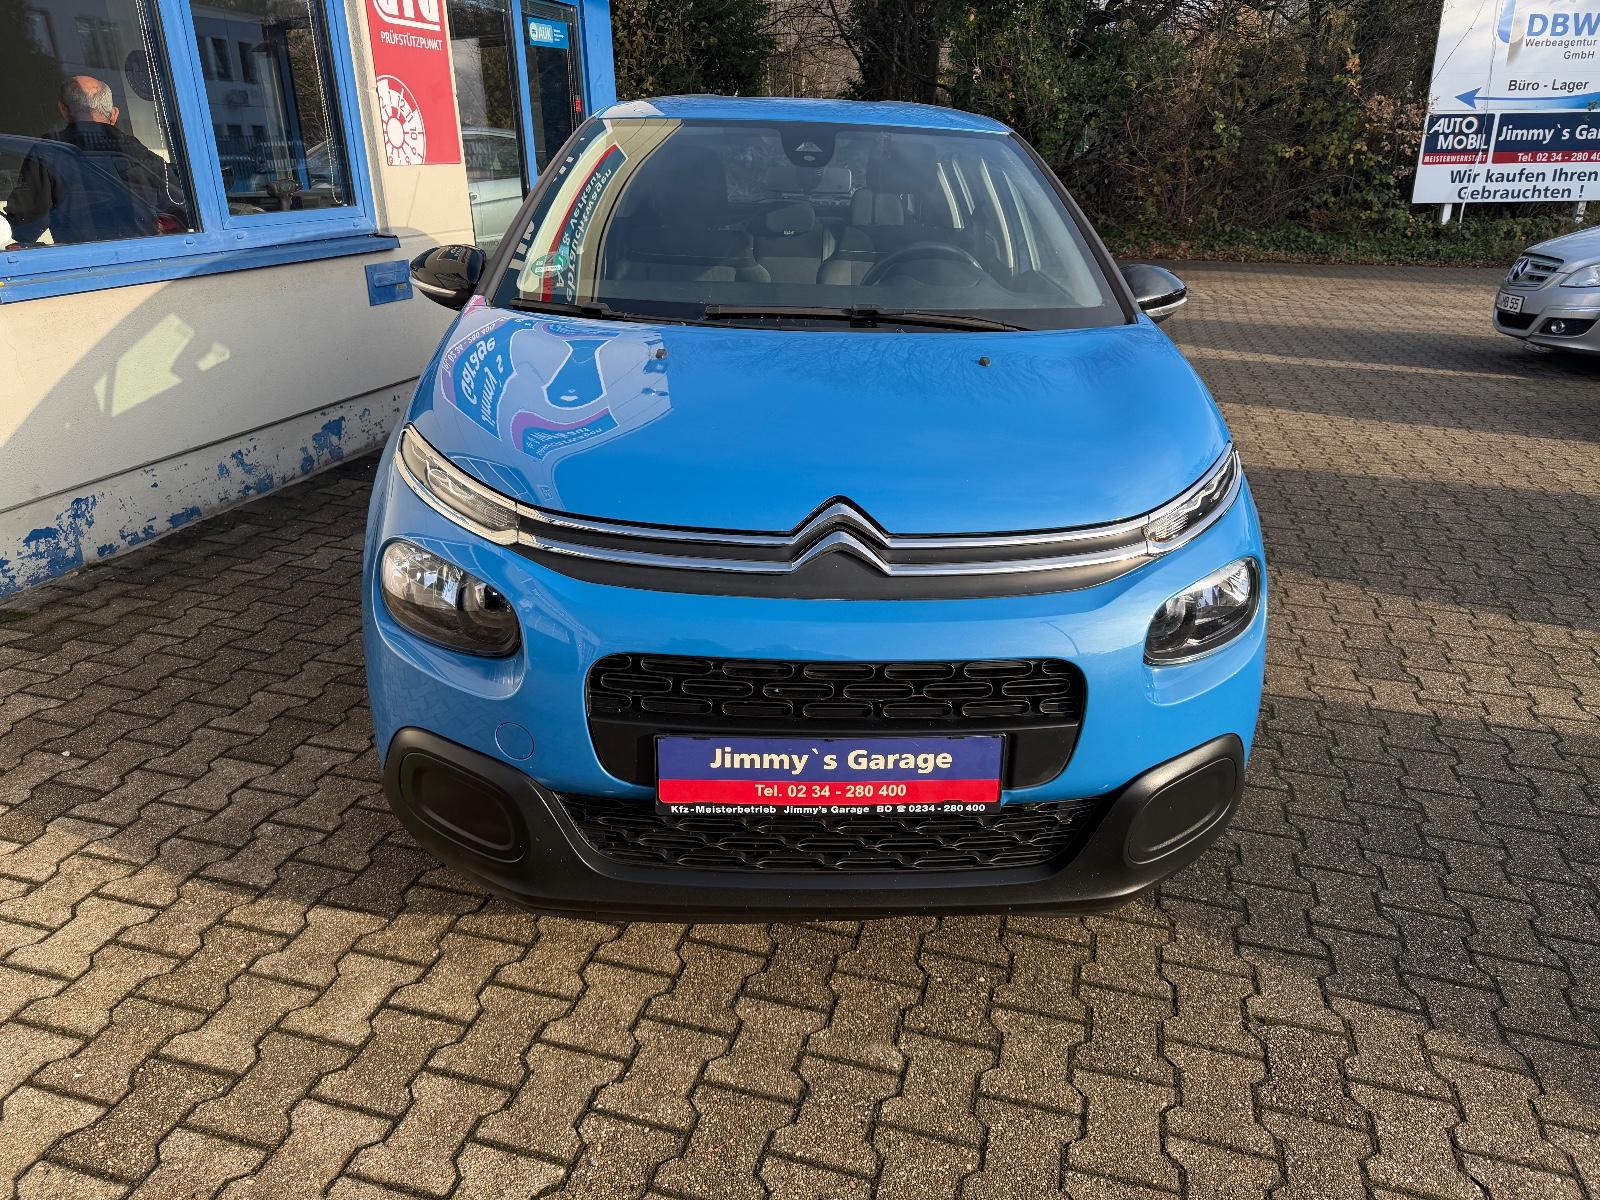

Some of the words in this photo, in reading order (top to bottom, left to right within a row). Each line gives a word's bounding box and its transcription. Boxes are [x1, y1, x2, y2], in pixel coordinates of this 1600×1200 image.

[380, 29, 442, 51] PRÜFSTÜTZPUNKT
[1525, 38, 1597, 48] Werbeagentur
[1563, 50, 1595, 60] GmbH
[1508, 79, 1540, 91] Büro
[1551, 78, 1589, 93] Lager
[1429, 116, 1478, 134] AUTO
[1437, 134, 1488, 150] MOBIL
[1517, 152, 1533, 162] Tel.
[1536, 152, 1548, 162] 02
[1550, 152, 1562, 161] 34
[1570, 152, 1588, 161] 280
[1450, 169, 1479, 184] Wir
[1485, 167, 1546, 183] kaufen
[1552, 167, 1598, 182] Ihren
[1457, 185, 1572, 200] Gebrauchten
[1578, 184, 1585, 199] !
[847, 750, 953, 774] Garage
[755, 784, 782, 797] Tel.
[787, 785, 807, 798] 02
[811, 785, 830, 798] 34
[846, 785, 874, 797] 280
[878, 785, 907, 797] 400
[670, 805, 777, 814] Kfz-Meisterbetrieb
[830, 805, 870, 814] Garage
[876, 805, 893, 813] BO
[908, 804, 935, 812] 0234
[943, 804, 961, 812] 280
[965, 804, 986, 812] 400
